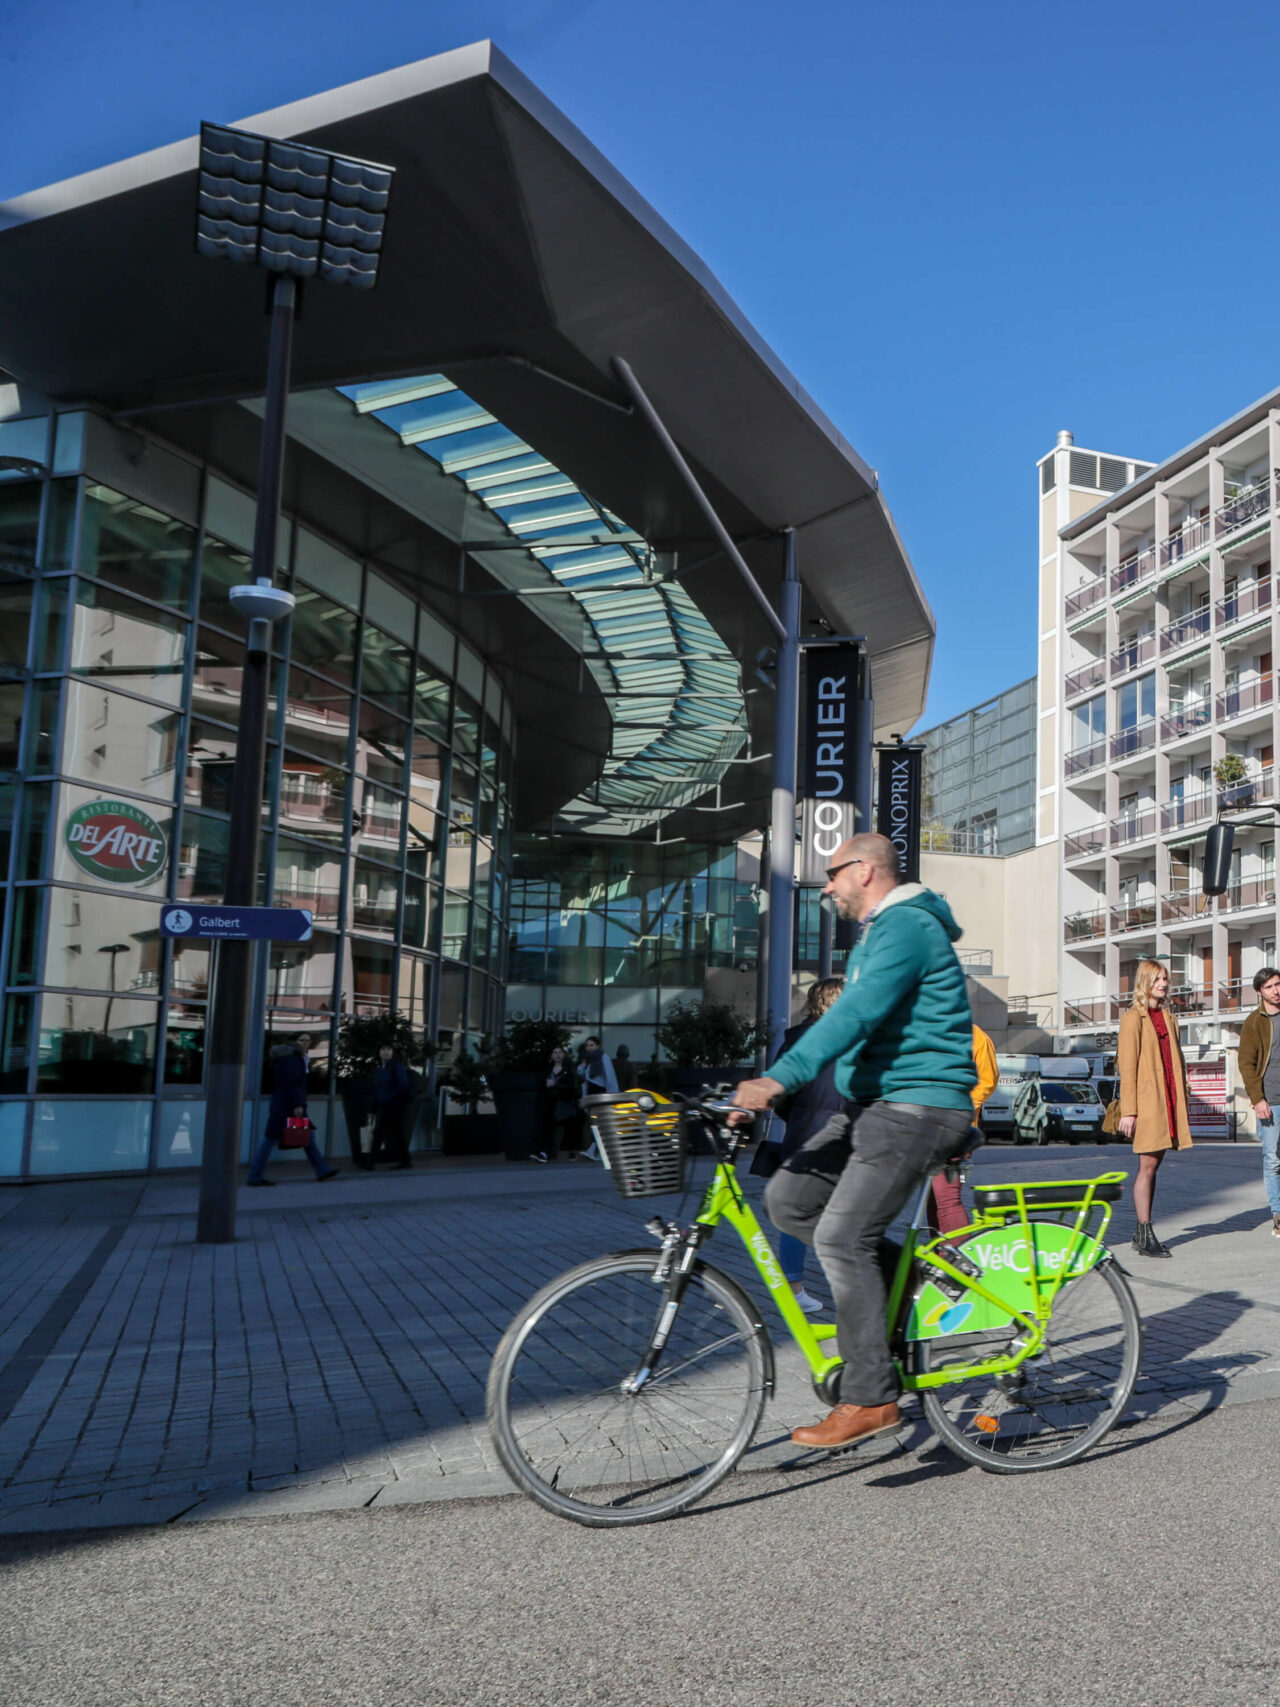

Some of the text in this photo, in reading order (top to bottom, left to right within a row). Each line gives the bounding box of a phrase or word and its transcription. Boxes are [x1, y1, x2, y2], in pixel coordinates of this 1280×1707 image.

[813, 676, 846, 857] COURIER
[69, 823, 163, 873] DEL ARTE
[199, 917, 241, 928] Galbert
[506, 1008, 590, 1023] OURIER
